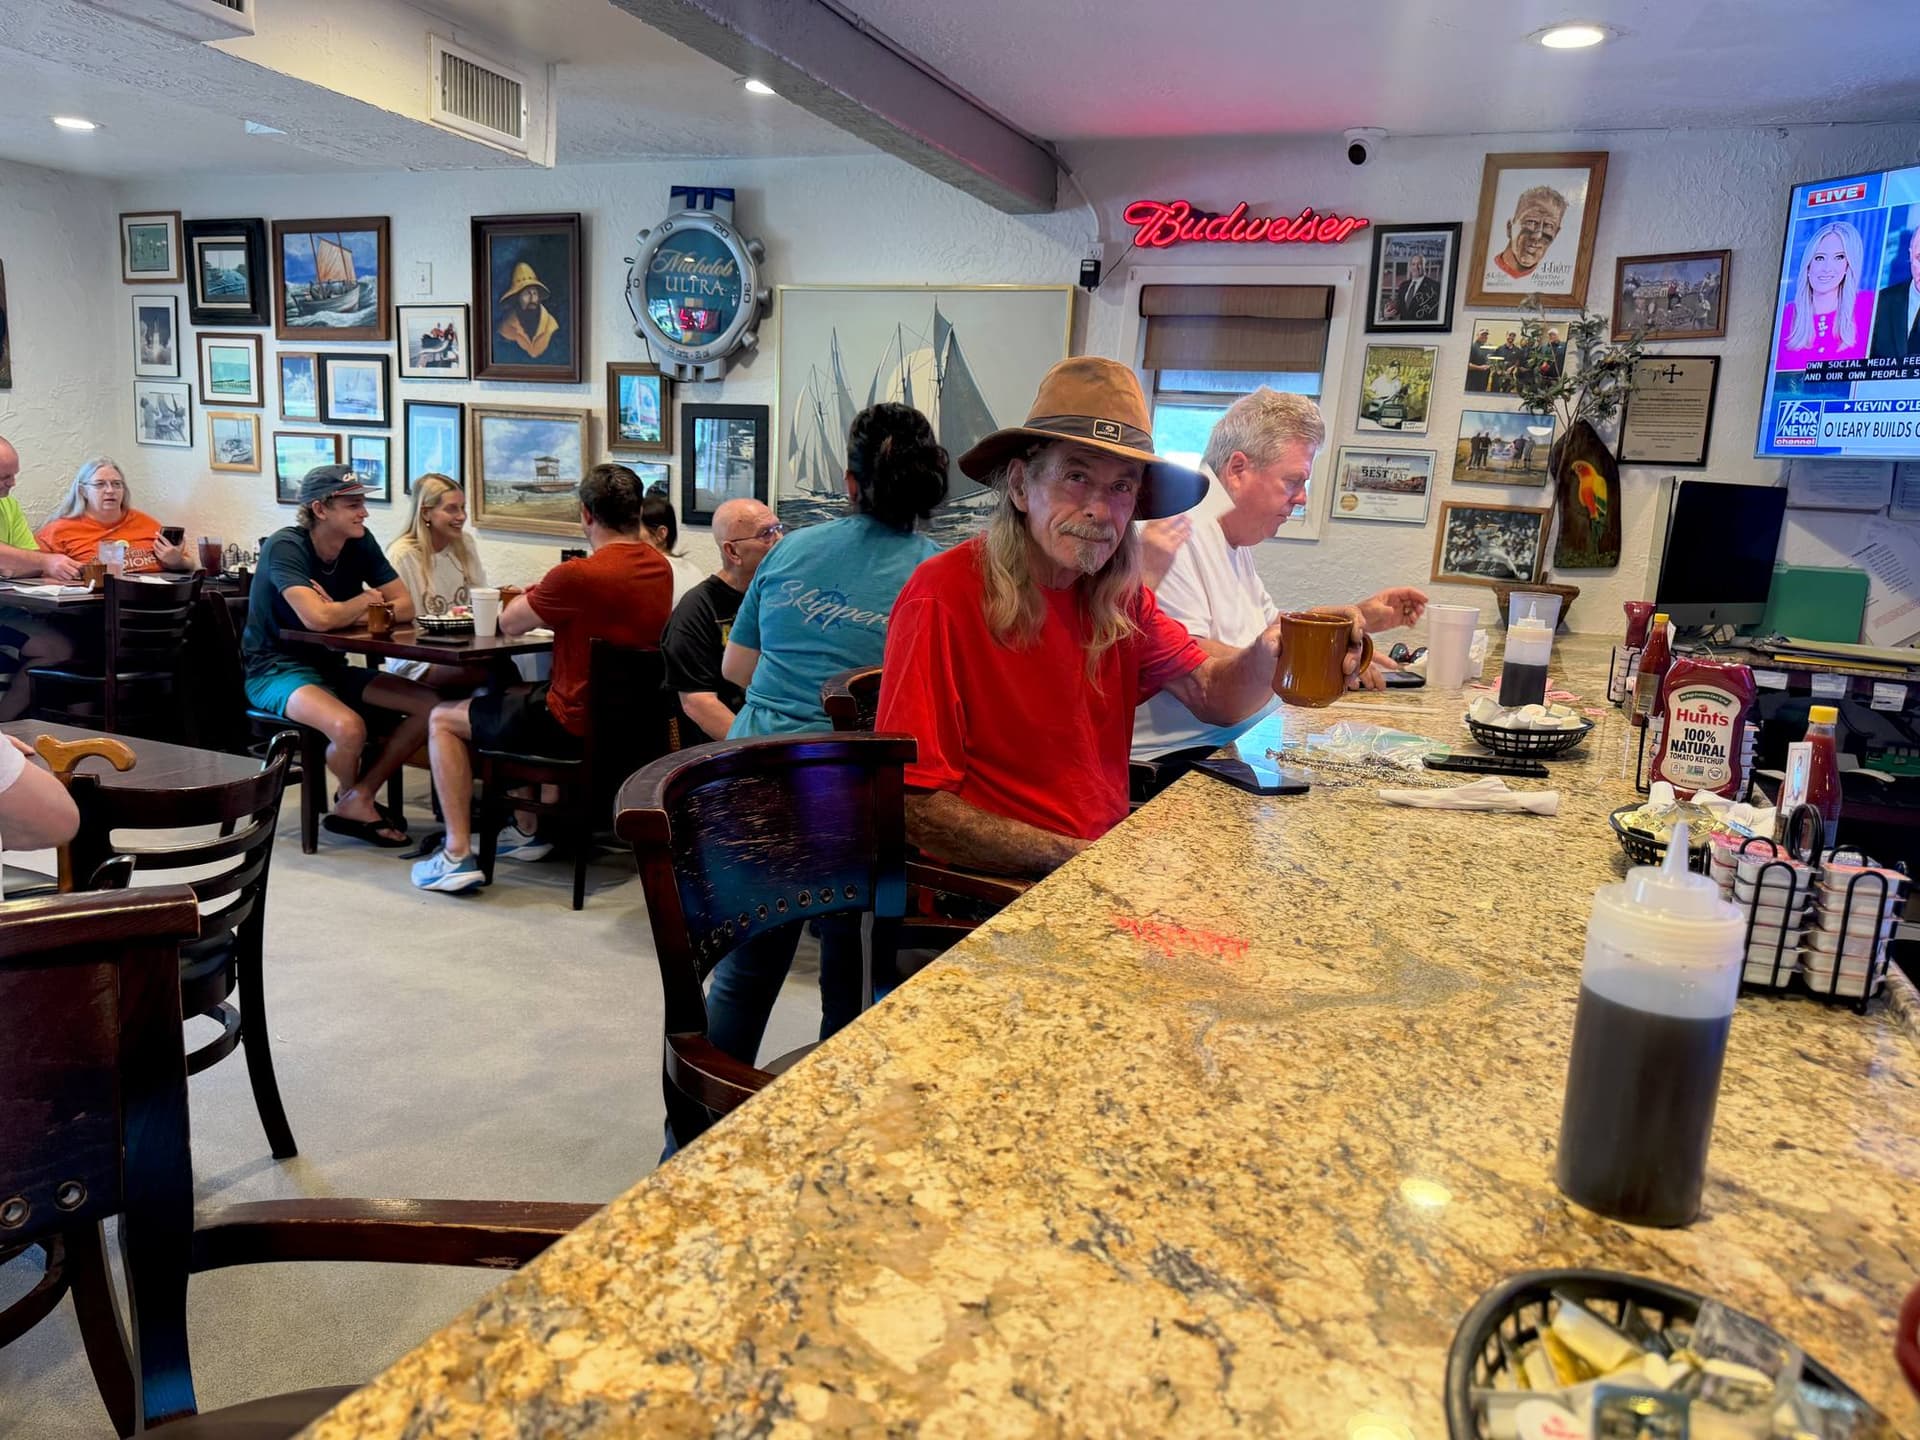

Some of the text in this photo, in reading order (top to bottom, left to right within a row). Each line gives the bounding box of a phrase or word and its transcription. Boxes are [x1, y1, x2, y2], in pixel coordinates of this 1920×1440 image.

[1815, 187, 1858, 203] LIVE
[660, 222, 674, 235] 10
[712, 222, 730, 240] 20
[1123, 199, 1370, 249] Budweiser
[651, 250, 734, 276] Michelob
[665, 276, 726, 296] ULTRA
[1806, 361, 1823, 370] OWN
[1828, 359, 1862, 369] SOCIAL
[1867, 358, 1897, 367] MEDIA
[1804, 372, 1822, 381] AND
[1826, 371, 1844, 380] OUR
[1848, 370, 1866, 379] OWN
[1871, 369, 1908, 379] PEOPLE
[1854, 401, 1893, 412] KEVIN
[1791, 411, 1819, 424] FOX
[1782, 425, 1817, 436] NEWS
[1824, 421, 1872, 438] O'LEARY
[1872, 421, 1913, 438] BUILDS
[1361, 468, 1388, 479] BEST
[1684, 728, 1716, 743] 100%
[1670, 739, 1726, 758] NATURAL
[1670, 752, 1724, 765] TOMATO KETCHUP
